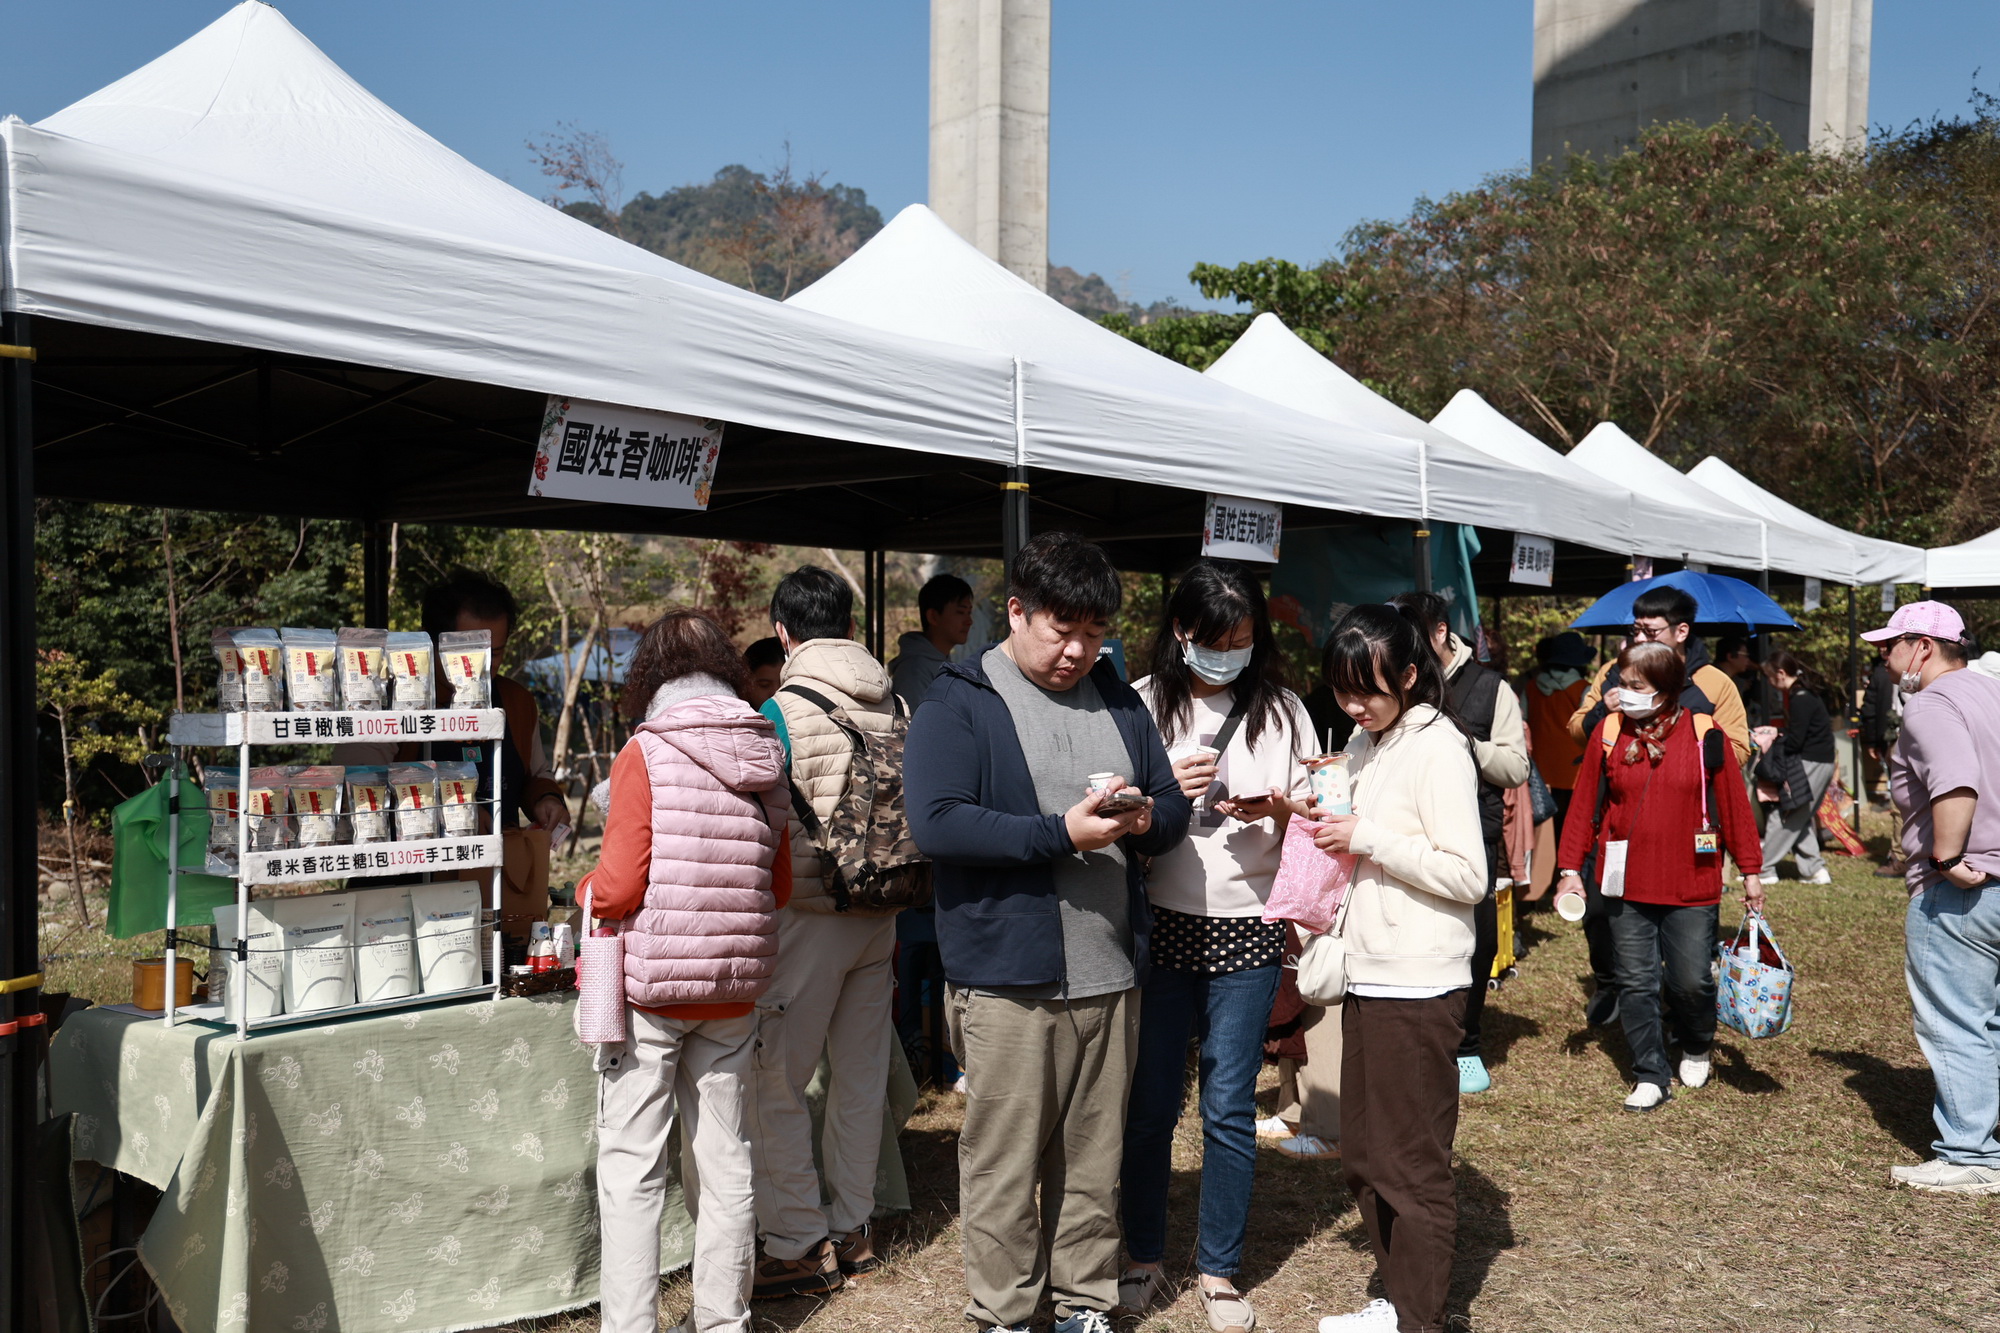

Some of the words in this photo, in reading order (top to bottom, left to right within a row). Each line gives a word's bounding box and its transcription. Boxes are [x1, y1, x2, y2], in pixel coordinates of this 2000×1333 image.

[556, 421, 703, 486] 國姓香咖啡
[1214, 506, 1274, 546] 國姓佳芳咖啡
[267, 844, 484, 877] 爆米香花生糖1包130元手工製作
